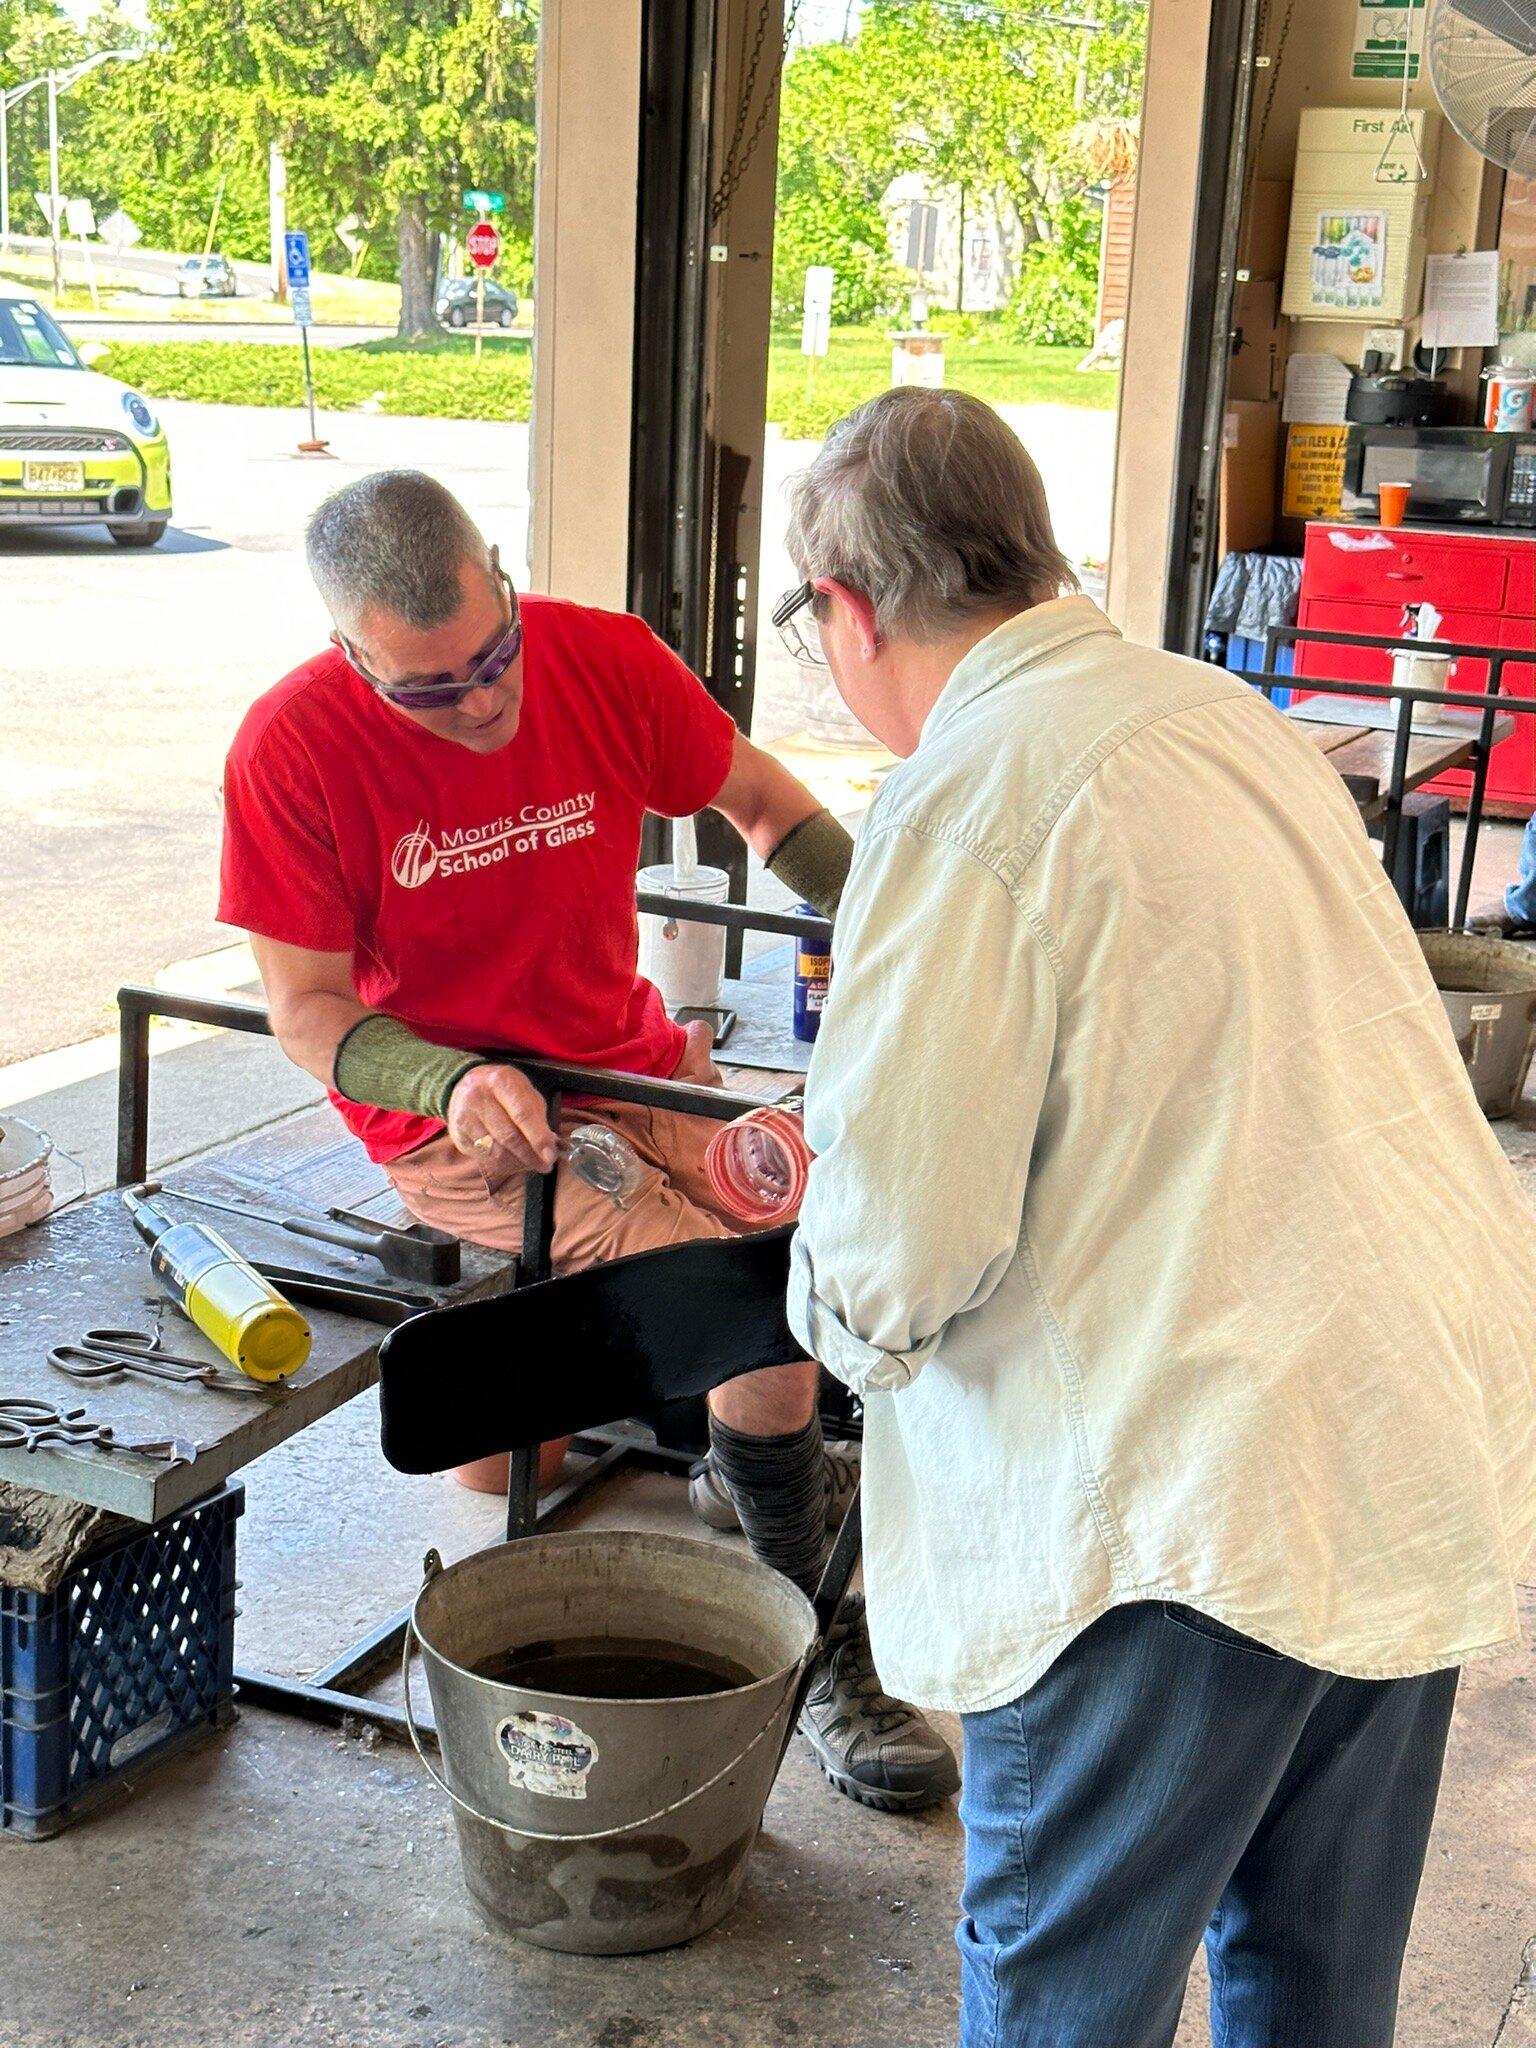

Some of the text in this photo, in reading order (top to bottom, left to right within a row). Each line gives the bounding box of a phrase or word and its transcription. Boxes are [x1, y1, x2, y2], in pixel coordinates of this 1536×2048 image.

[1353, 119, 1383, 133] First
[468, 235, 498, 255] STOP
[441, 792, 596, 849] Morris County
[439, 821, 596, 878] School of Glass
[511, 1745, 548, 1761] DAIRY
